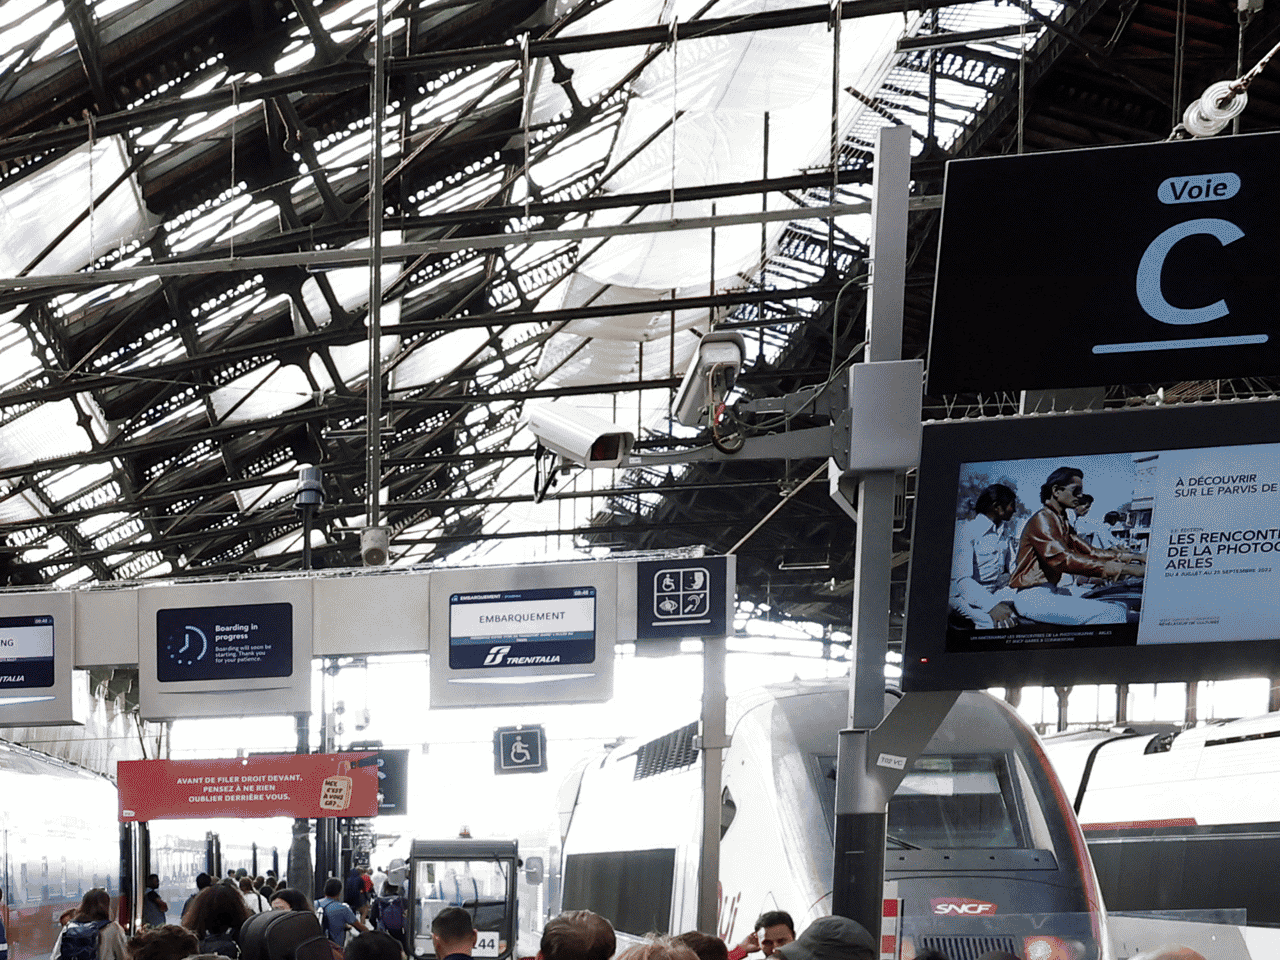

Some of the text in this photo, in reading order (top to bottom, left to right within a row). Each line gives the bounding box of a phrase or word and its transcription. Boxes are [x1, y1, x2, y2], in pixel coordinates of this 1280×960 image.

[1170, 179, 1228, 200] Voie
[1136, 218, 1245, 325] C
[1176, 474, 1257, 487] À DÉCOUVRIR
[1175, 483, 1278, 497] SUR LE PARVIS DE
[1169, 528, 1280, 545] LES RENCONT
[1168, 547, 1188, 557] DE
[1193, 545, 1212, 556] LA
[1165, 557, 1213, 570] ARLES
[479, 611, 566, 623] EMBARQUEMENT
[215, 624, 249, 632] Boarding
[215, 633, 248, 642] progress
[507, 655, 560, 664] TRENITALIA
[176, 777, 203, 785] AVANT
[205, 776, 216, 784] DE
[242, 775, 267, 783] DROIT
[203, 785, 234, 793] PENSEZ
[236, 783, 242, 792] À
[934, 904, 992, 914] SNCF
[474, 938, 495, 950] 44
